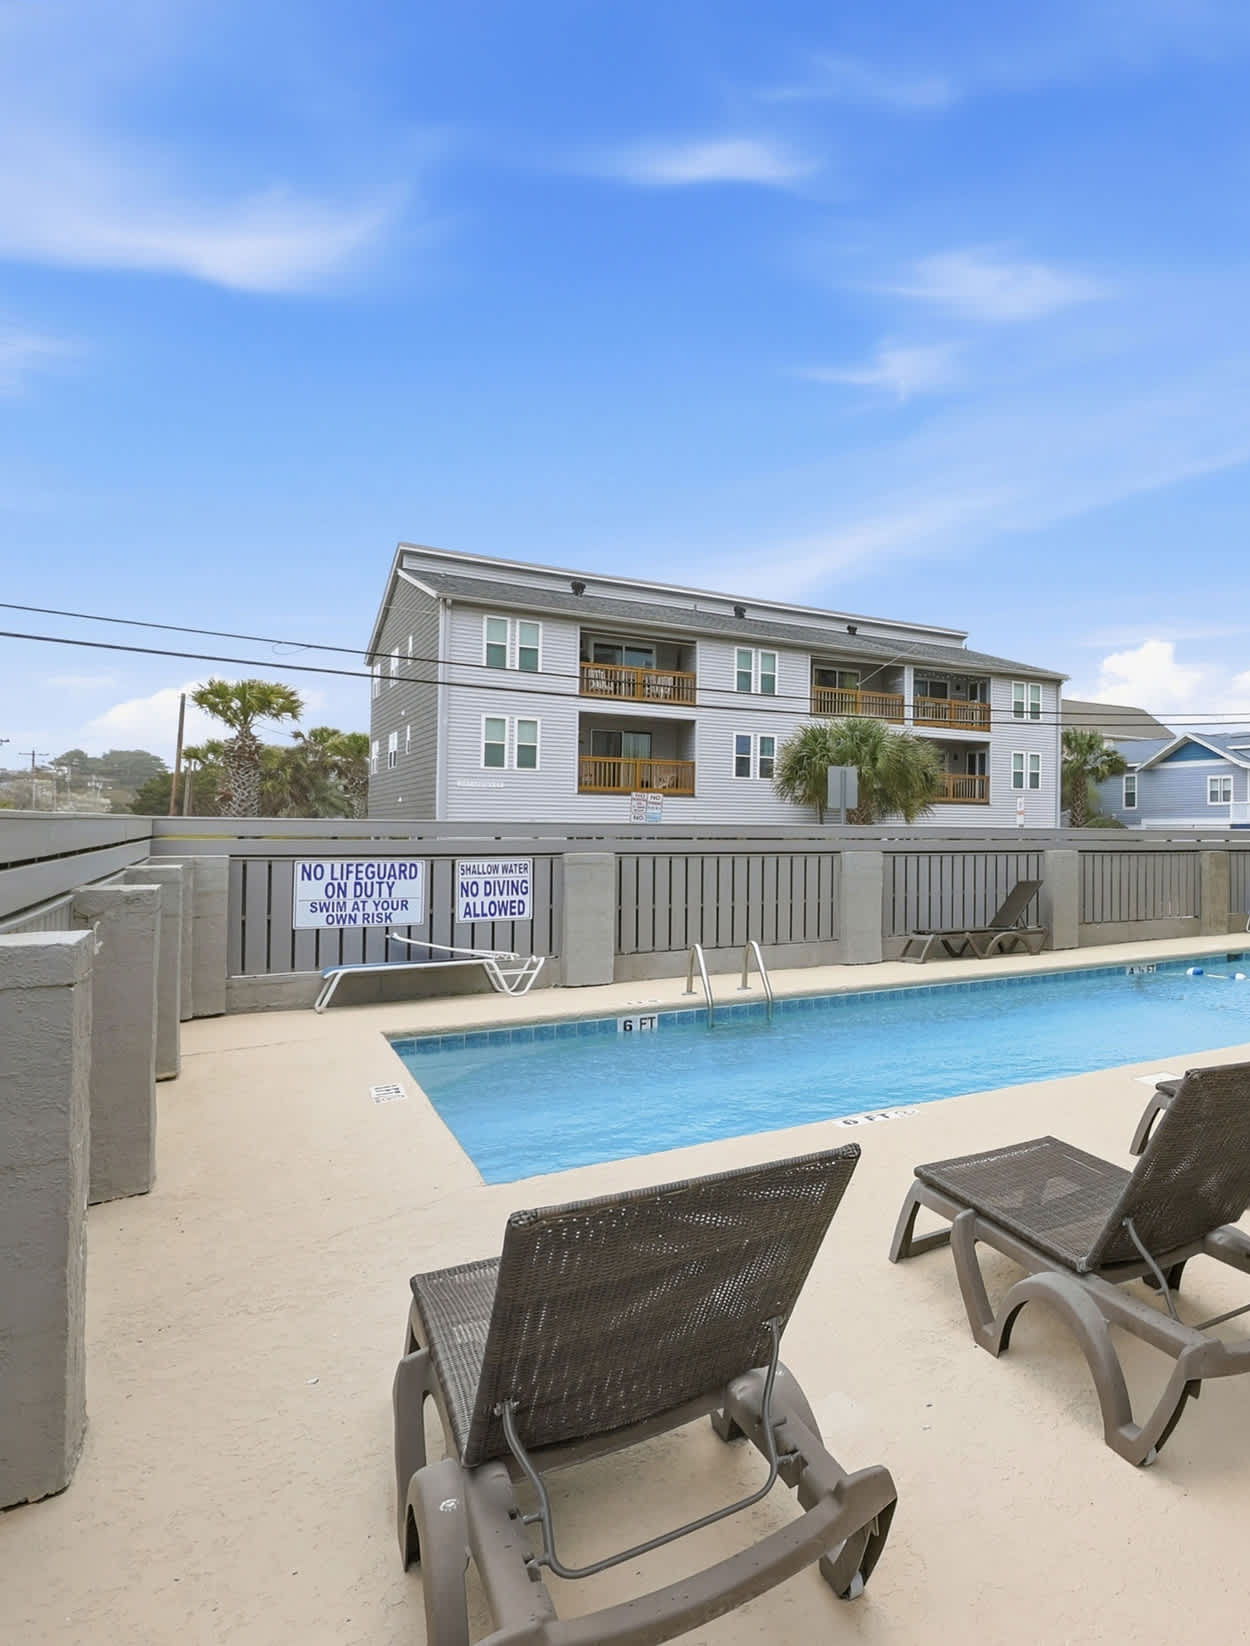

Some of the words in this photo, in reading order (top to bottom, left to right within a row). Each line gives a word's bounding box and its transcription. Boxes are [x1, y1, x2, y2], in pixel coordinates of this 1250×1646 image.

[301, 863, 325, 881] NO
[330, 862, 418, 881] LIFEGUARD
[460, 863, 499, 876] SHALLOW
[501, 863, 529, 875] WATER
[325, 882, 349, 899] ON
[353, 881, 396, 899] DUTY
[460, 881, 479, 898] NO
[484, 879, 529, 897] DIVING
[309, 900, 347, 914] SWIM
[351, 900, 369, 912] AT
[373, 899, 409, 912] YOUR
[463, 899, 526, 919] ALLOWED
[325, 913, 357, 926] OWN
[361, 912, 393, 924] RISK
[623, 1019, 633, 1032] 6
[640, 1016, 656, 1031] FT
[864, 1113, 889, 1121] FT
